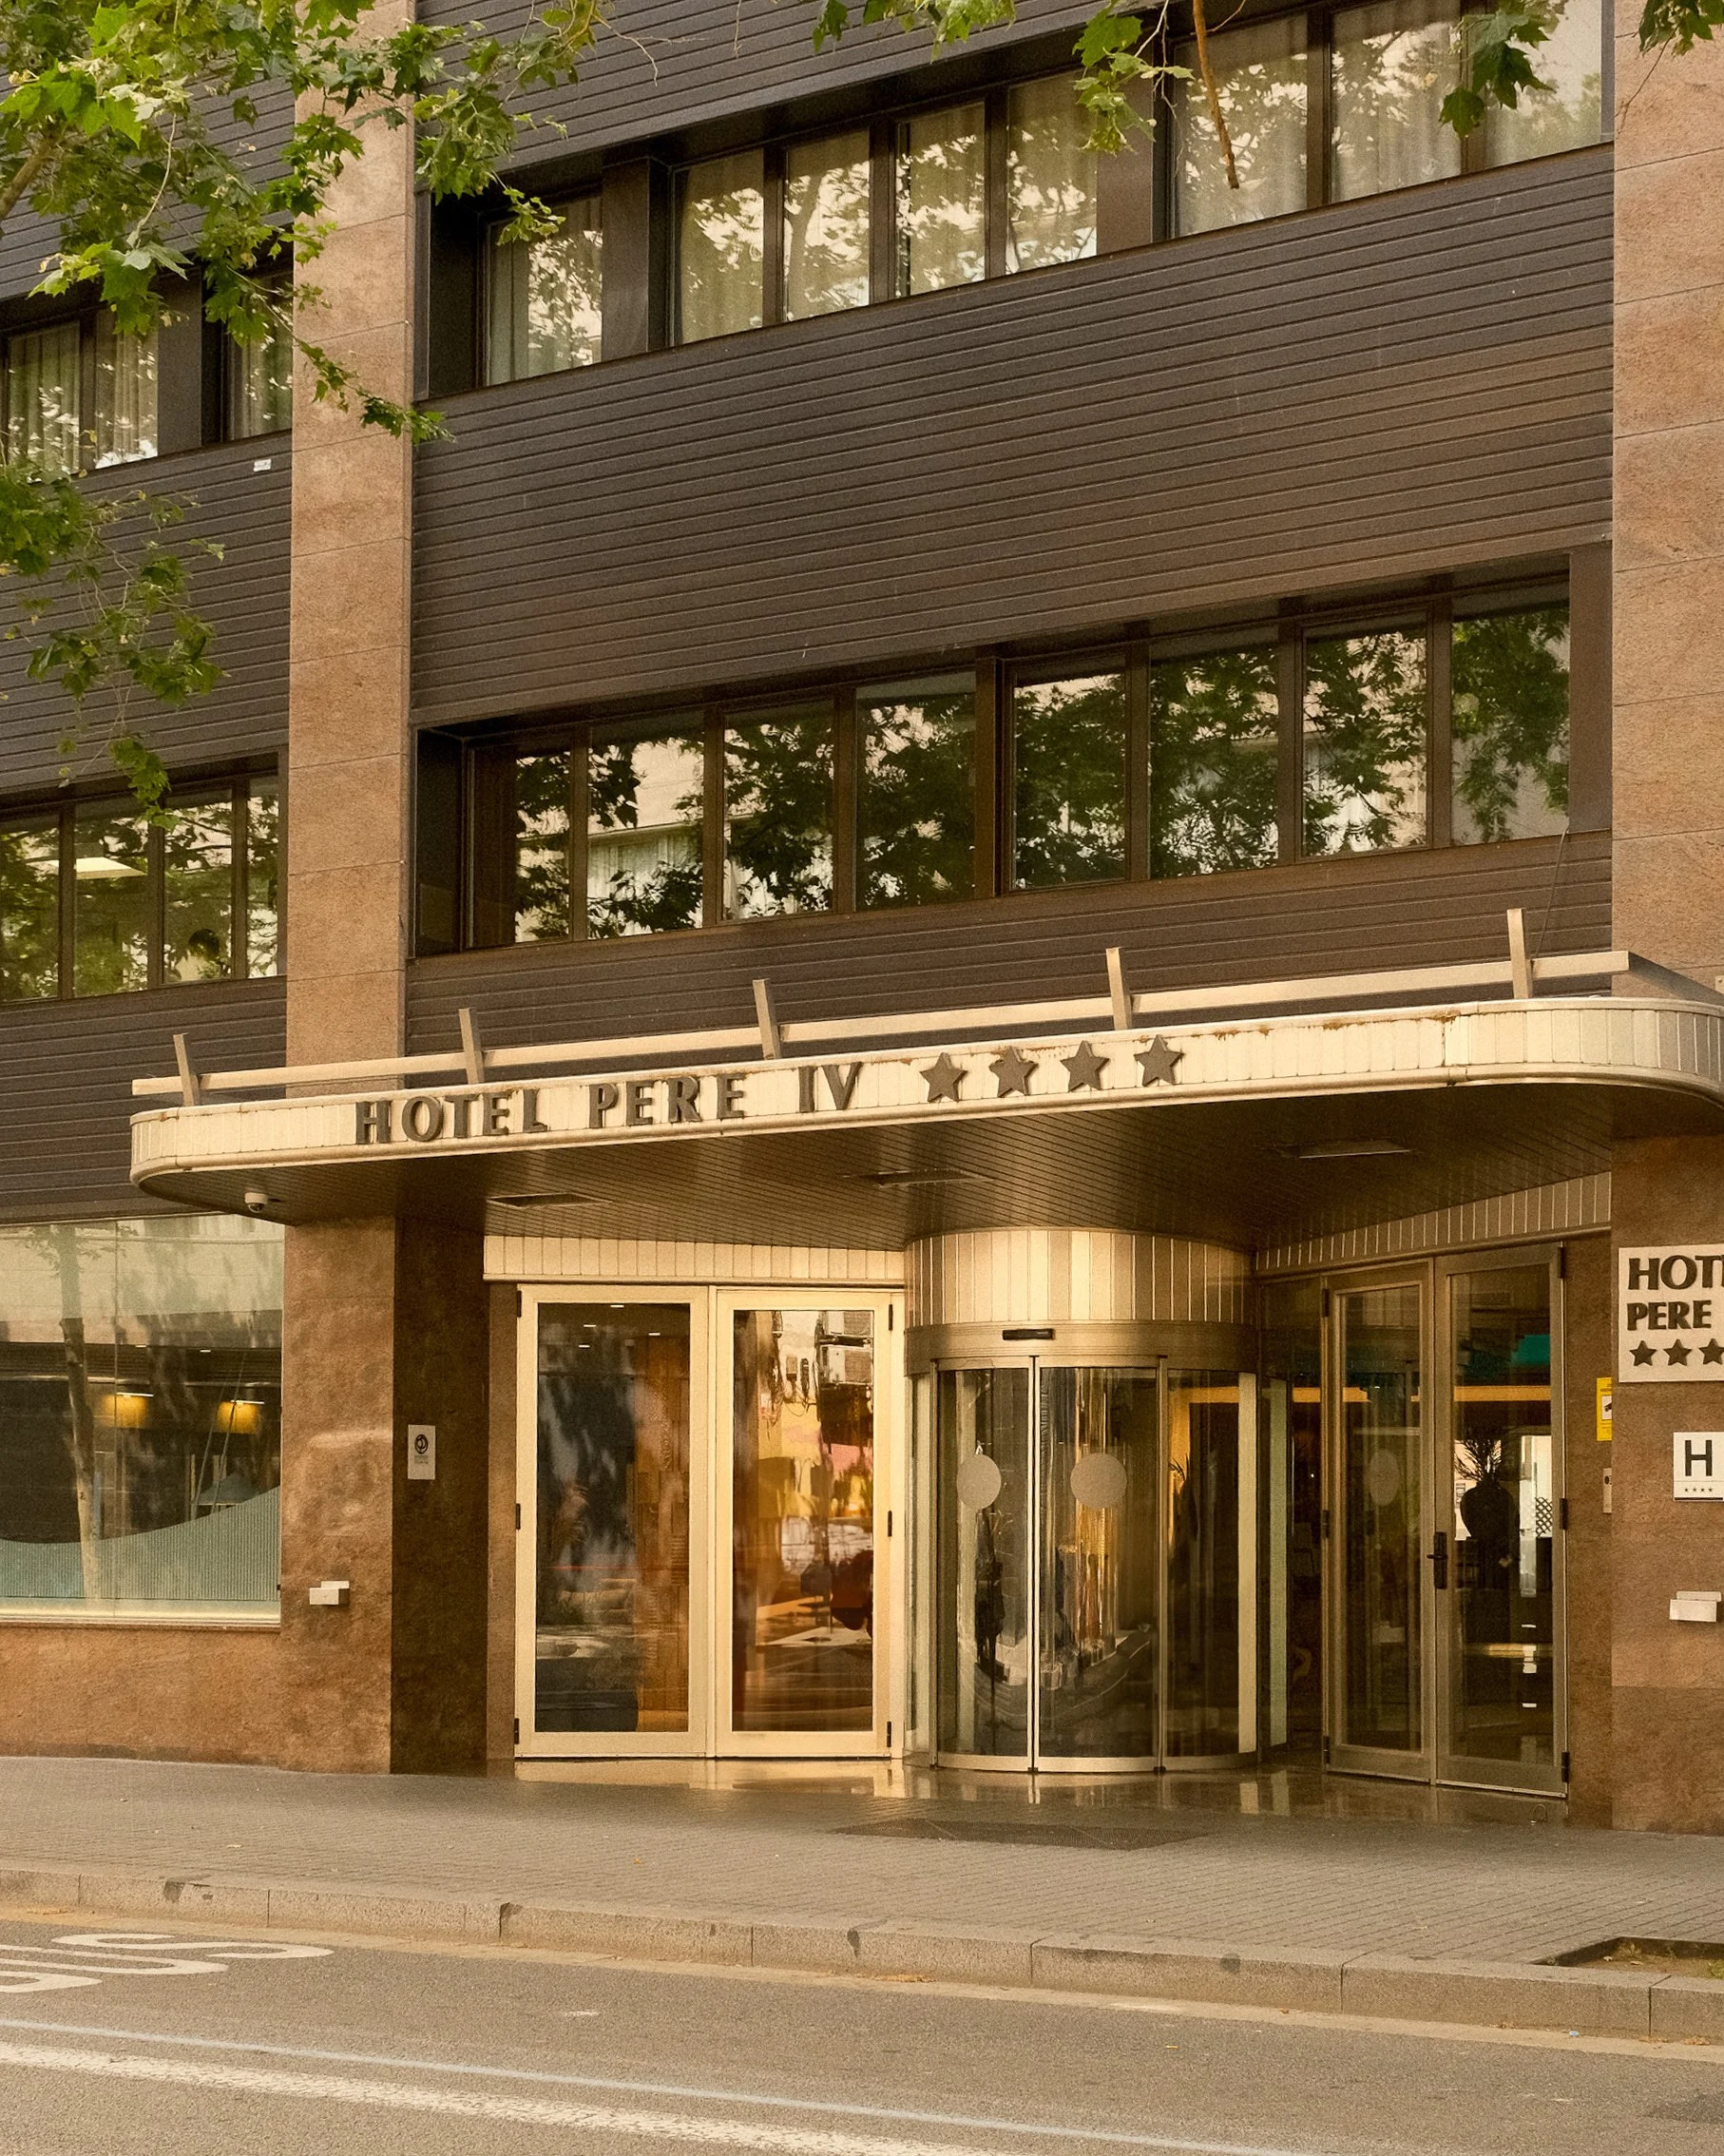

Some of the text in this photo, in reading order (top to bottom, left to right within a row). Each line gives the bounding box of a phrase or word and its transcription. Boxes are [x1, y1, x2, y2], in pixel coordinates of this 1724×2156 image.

[355, 1062, 863, 1145] HOTEL PERE IV
[1628, 1255, 1724, 1290] HOT
[1627, 1299, 1713, 1331] PERE
[1684, 1439, 1713, 1476] H
